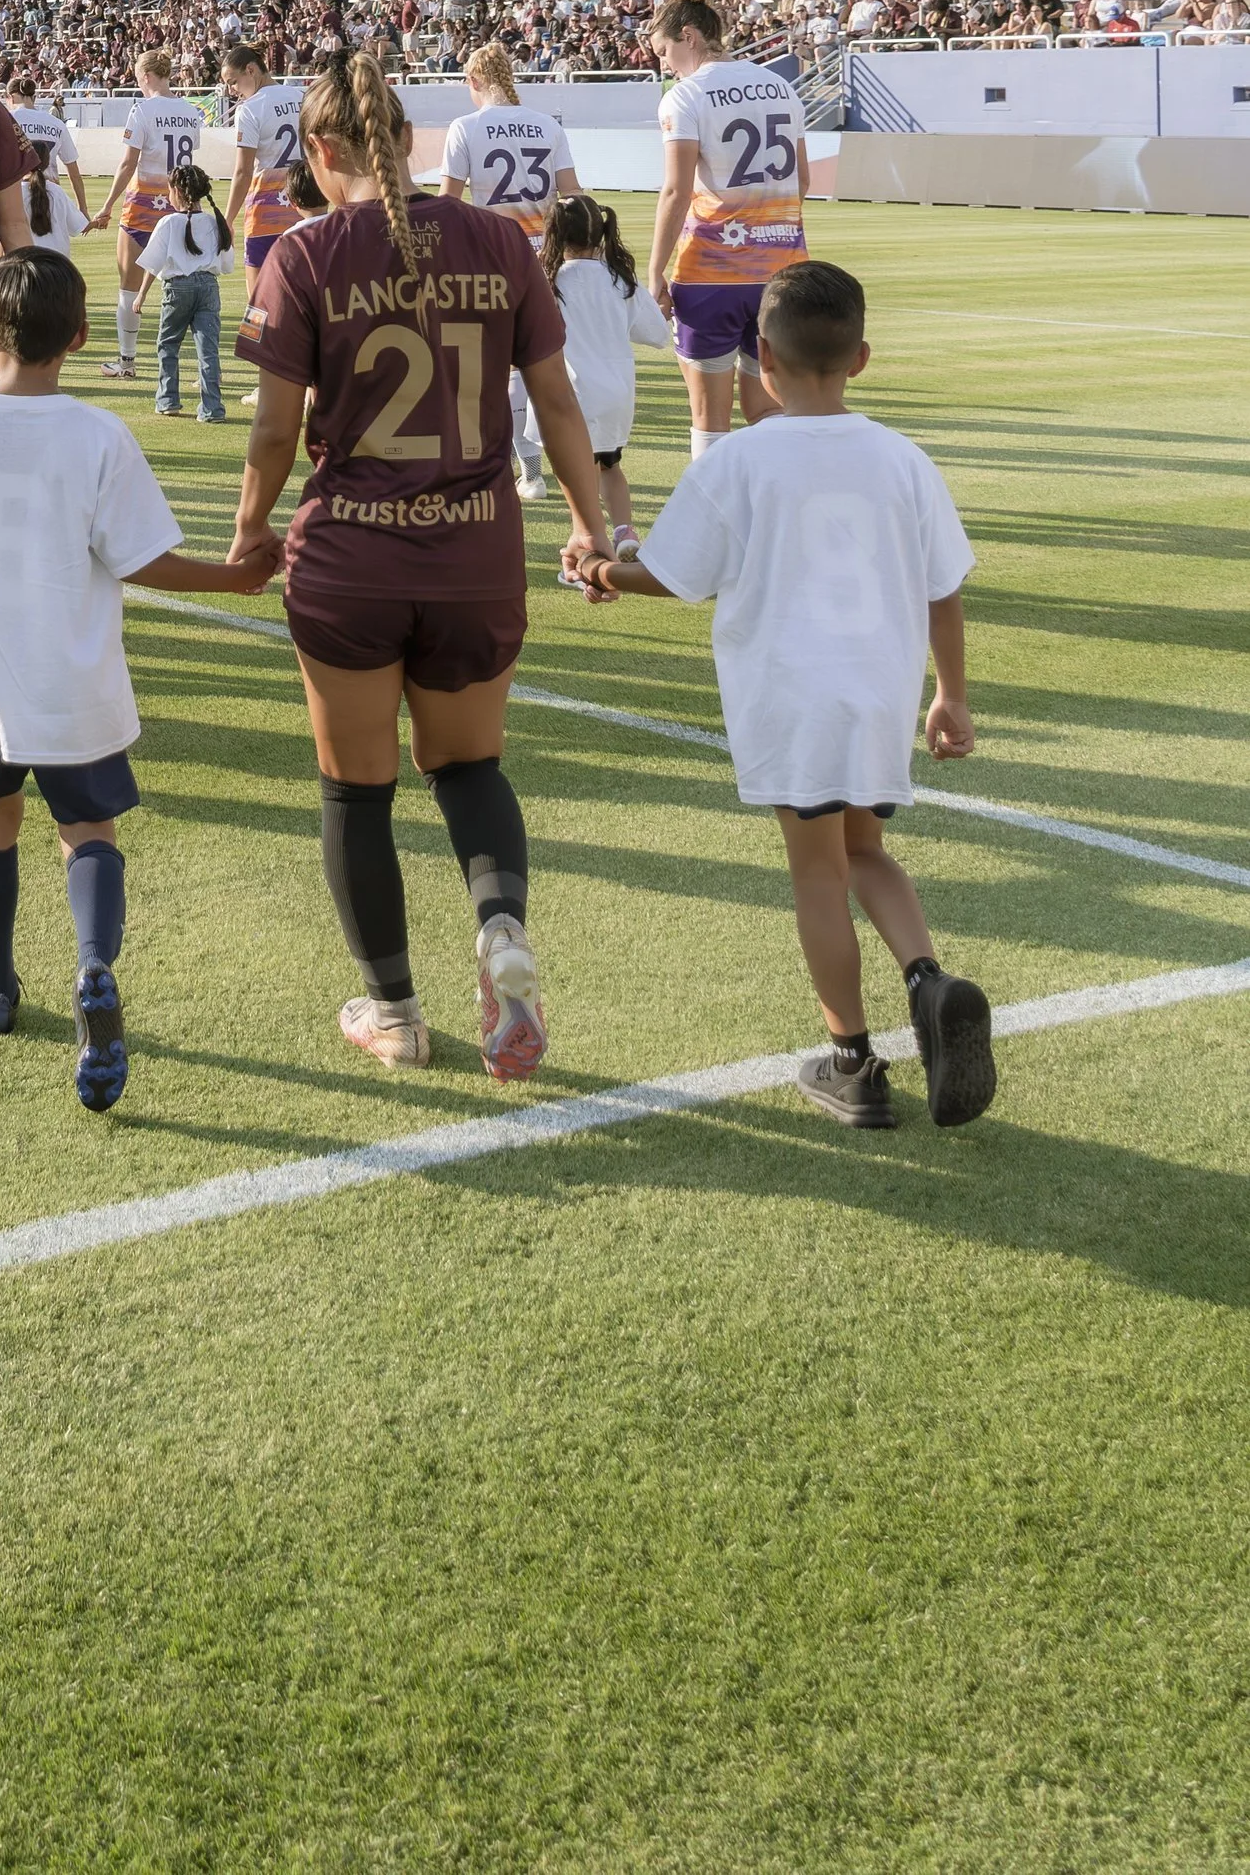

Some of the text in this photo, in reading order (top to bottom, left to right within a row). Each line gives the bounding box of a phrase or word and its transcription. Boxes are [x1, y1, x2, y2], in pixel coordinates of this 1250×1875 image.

[706, 83, 790, 107] TROCCOLI
[156, 116, 197, 129] HARDING
[486, 124, 544, 139] PARKER
[164, 134, 193, 174] 18
[274, 124, 299, 168] 2
[721, 113, 796, 188] 25
[484, 148, 551, 205] 23
[387, 221, 440, 236] LAS
[387, 233, 442, 248] TNITY
[749, 225, 800, 239] SUNBELT
[324, 273, 509, 323] LANCASTER
[349, 322, 483, 460] 21
[331, 490, 496, 527] trust&will
